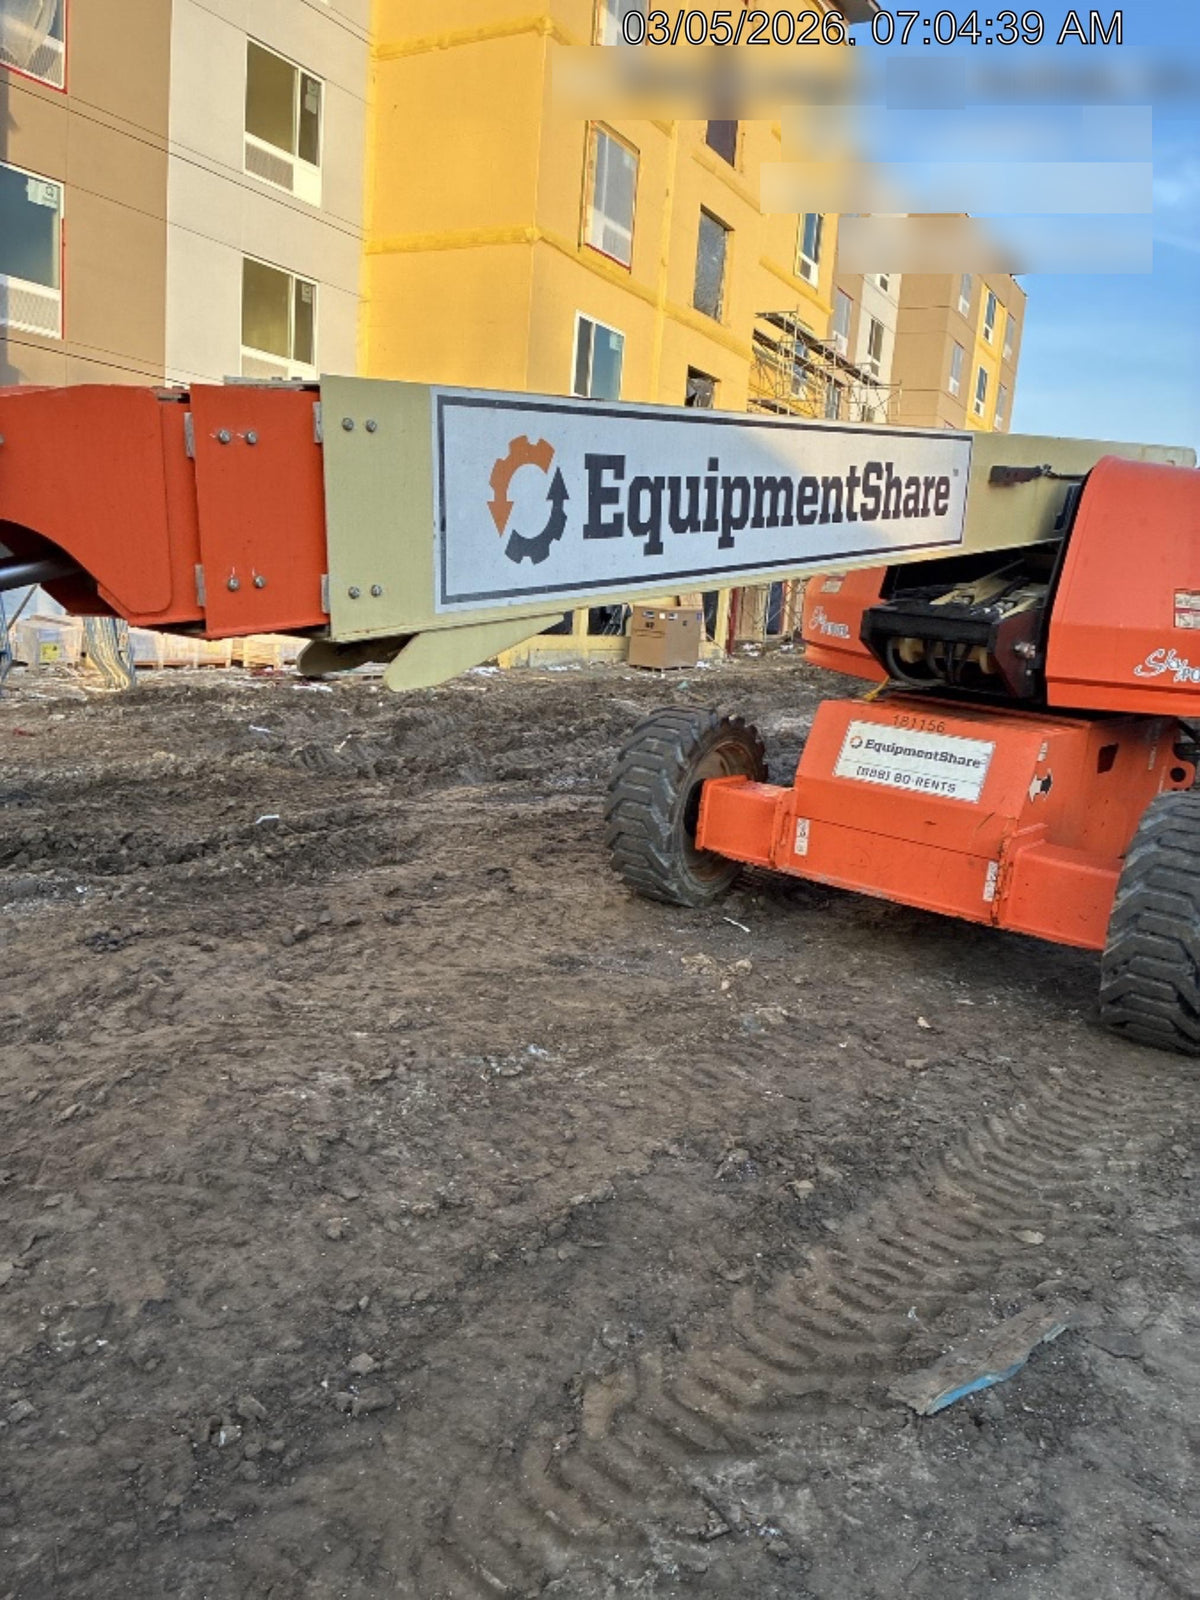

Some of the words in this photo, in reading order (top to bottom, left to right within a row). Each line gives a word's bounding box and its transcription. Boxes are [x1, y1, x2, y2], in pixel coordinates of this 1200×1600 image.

[583, 453, 950, 556] EquipmentShare
[893, 714, 946, 733] 181156
[864, 739, 982, 769] EquipmentShare
